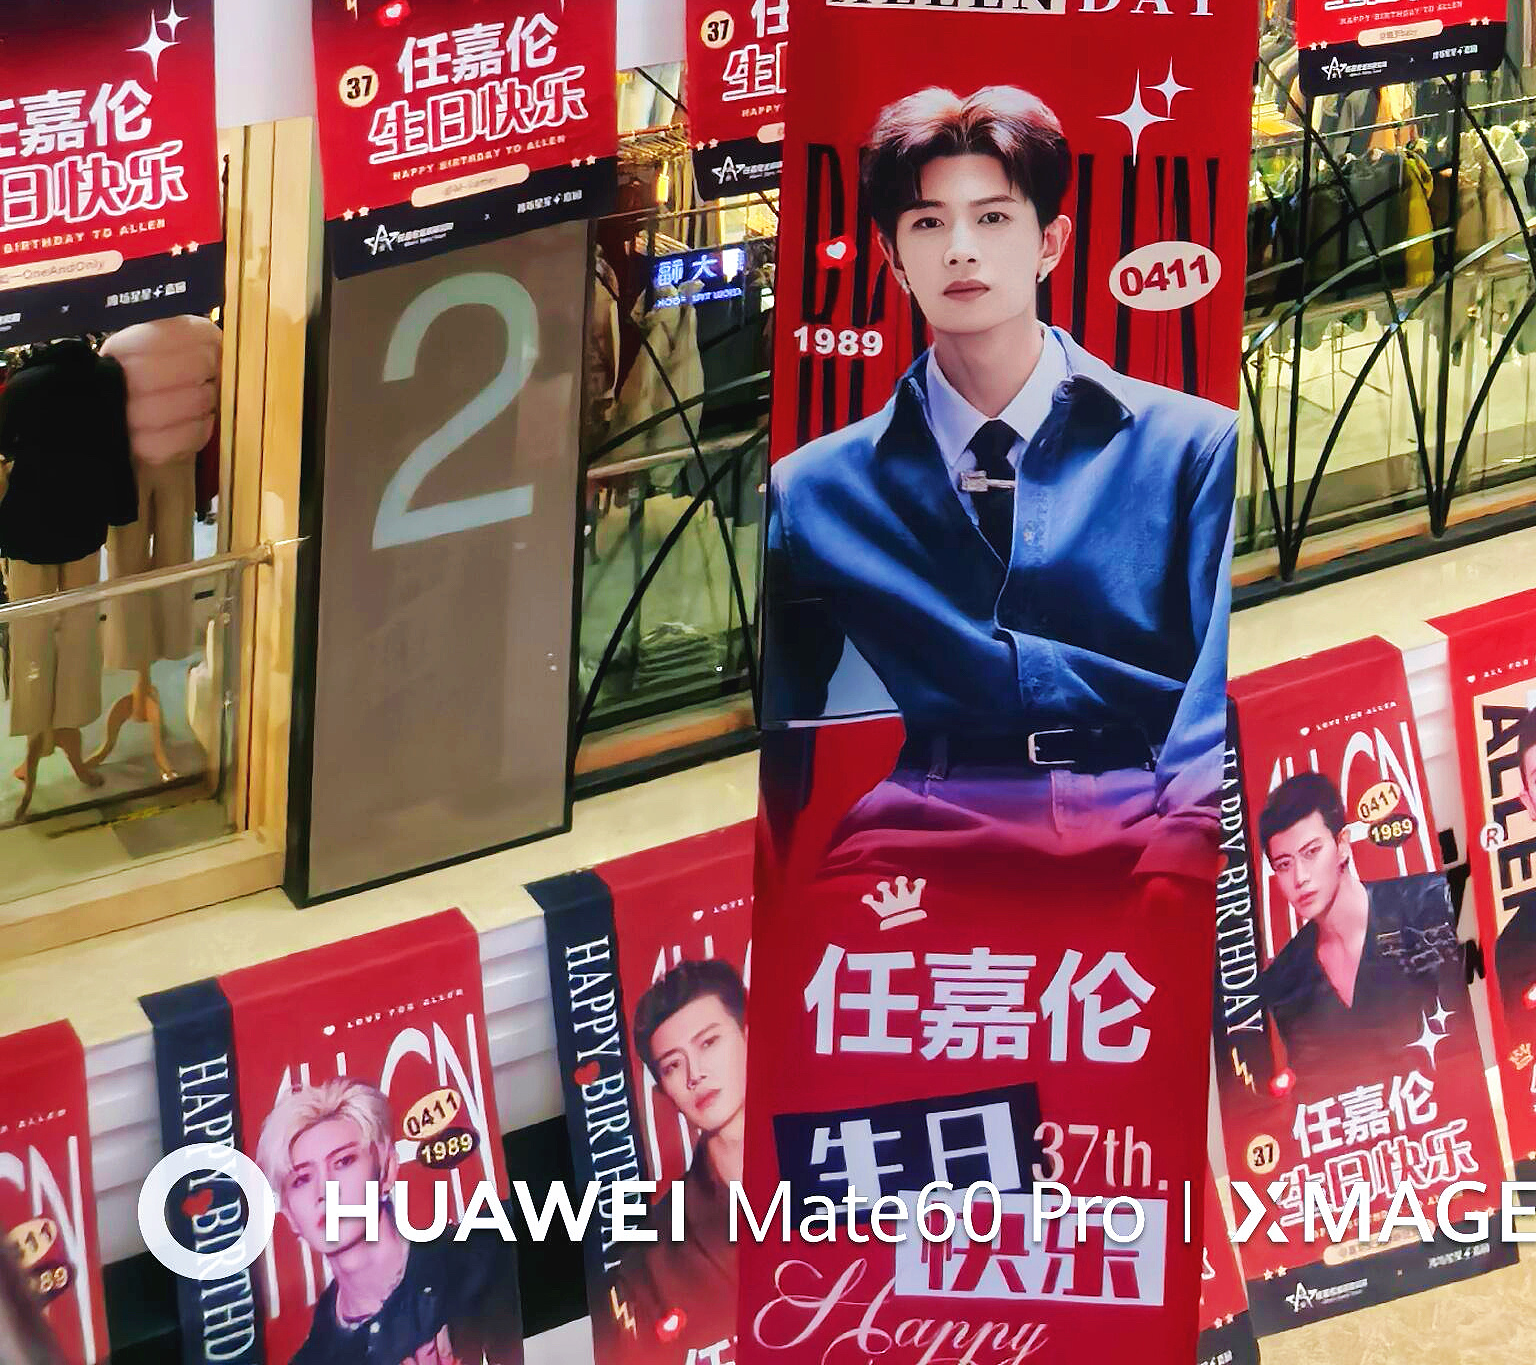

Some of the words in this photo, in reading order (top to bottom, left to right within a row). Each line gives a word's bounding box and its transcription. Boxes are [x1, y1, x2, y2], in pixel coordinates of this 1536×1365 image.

[707, 19, 730, 42] 37
[396, 15, 560, 96] 任嘉伦
[347, 74, 373, 99] 37
[367, 67, 589, 167] 生日快乐
[392, 163, 434, 182] HAPPY
[505, 144, 524, 156] TO
[526, 132, 567, 151] ALLEN
[3, 232, 84, 254] BIRTHDAY
[93, 228, 113, 239] TO
[119, 219, 166, 236] ALLEN
[1119, 254, 1212, 298] 0411
[793, 325, 884, 358] 1989
[372, 272, 540, 550] 2
[1360, 785, 1399, 819] 0411
[1370, 820, 1415, 845] 1989
[1219, 857, 1264, 1036] BIRTHDAY
[804, 943, 1156, 1063] 任嘉伦
[405, 1093, 461, 1135] 0411
[1290, 1070, 1437, 1158] 任嘉伦
[420, 1134, 474, 1165] 1989
[811, 1102, 1024, 1216] 生日
[1252, 1144, 1275, 1168] 37
[919, 1200, 1142, 1300] 快乐
